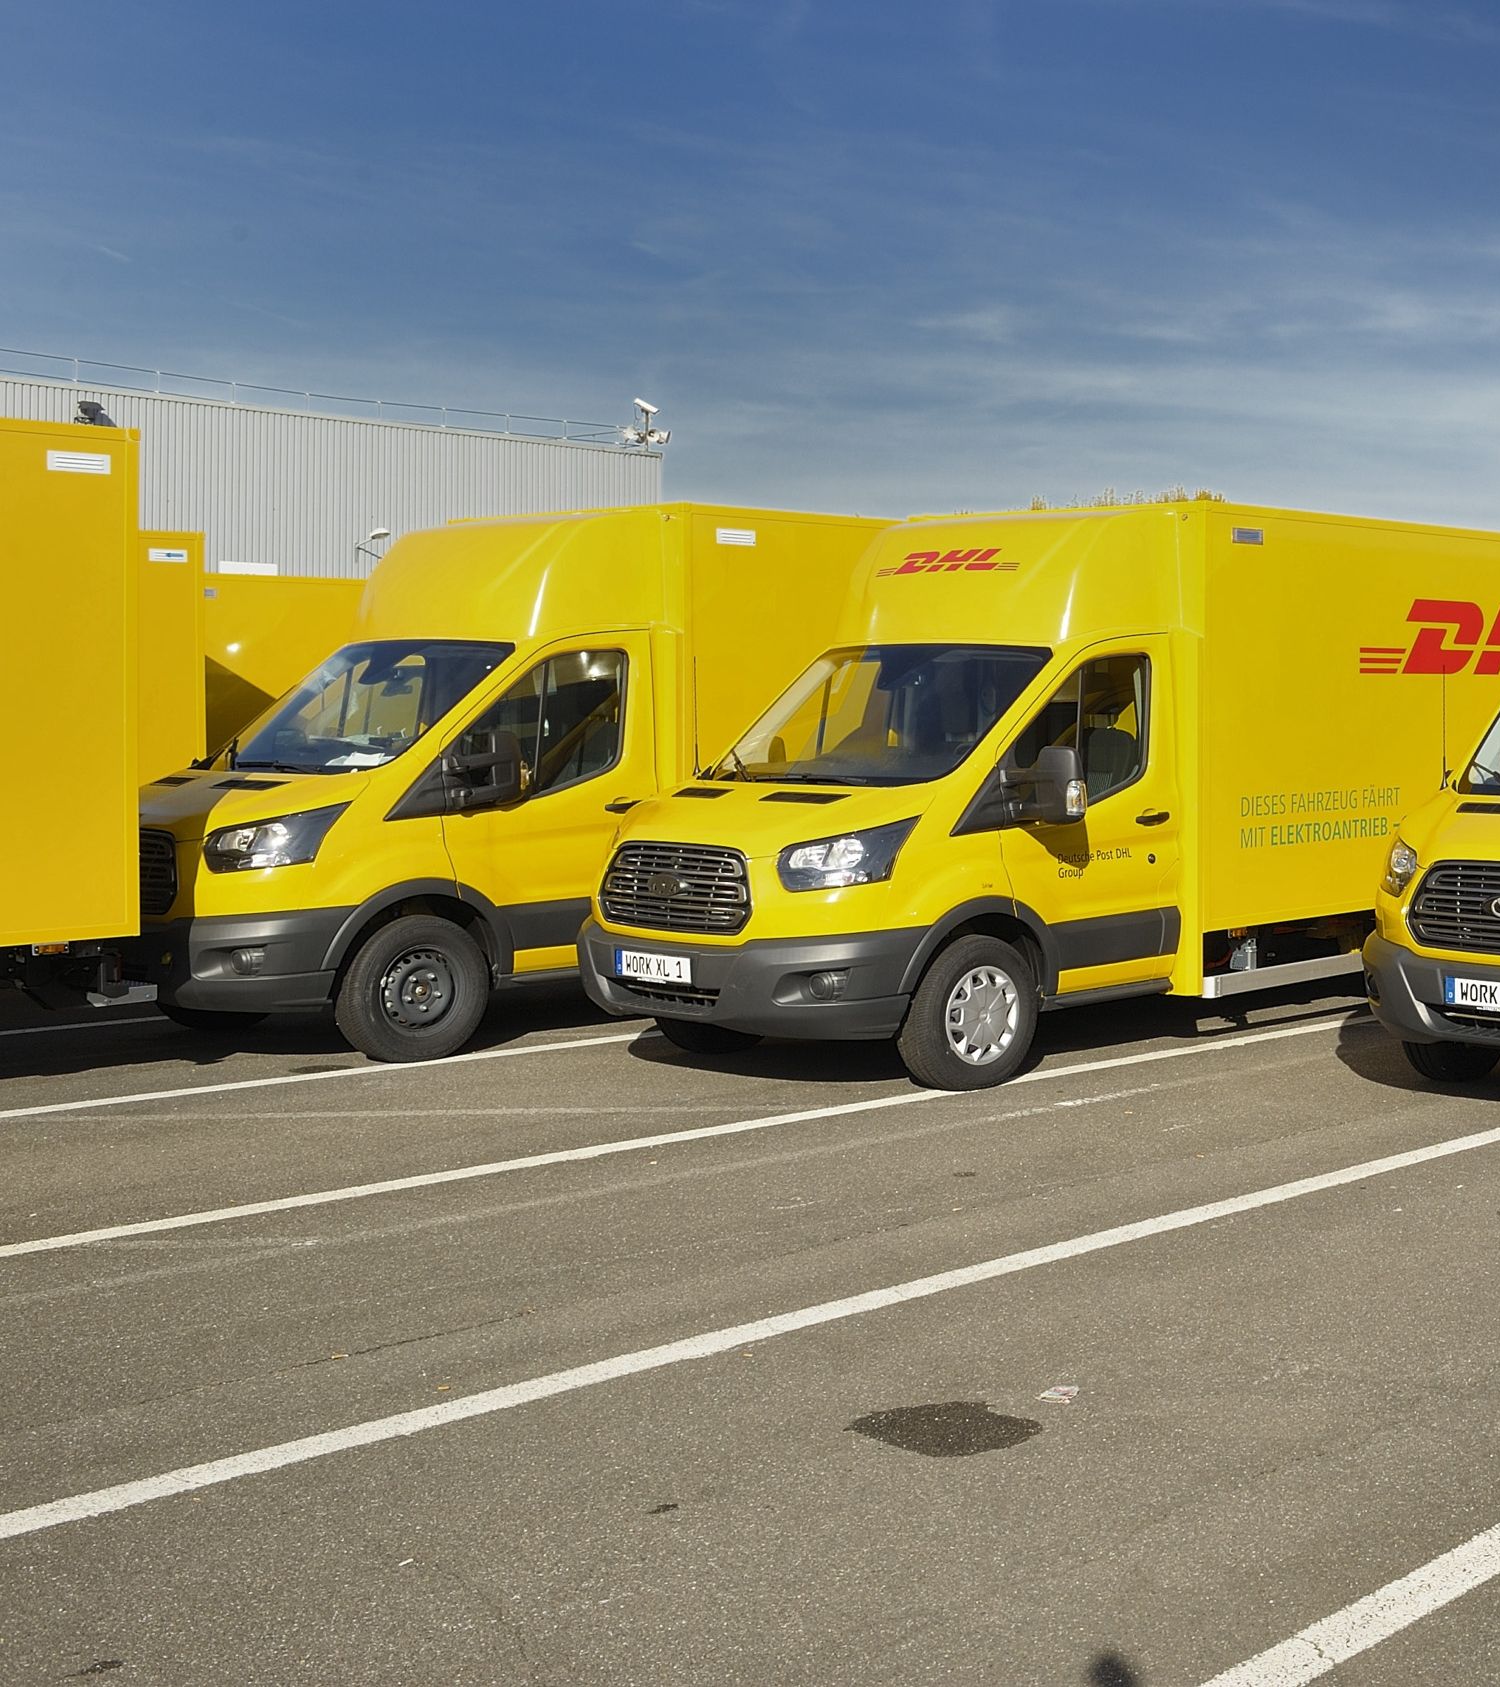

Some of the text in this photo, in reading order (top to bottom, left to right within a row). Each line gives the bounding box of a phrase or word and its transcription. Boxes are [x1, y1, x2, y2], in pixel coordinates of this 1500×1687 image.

[894, 548, 1002, 575] DHL
[1240, 785, 1400, 817] DIESES FAHRZEUG FÄHRT
[1240, 826, 1266, 849] MIT
[1057, 848, 1132, 865] Deutsche Post DHL
[1058, 867, 1084, 879] Group
[625, 954, 683, 978] WORK XL 1
[1460, 982, 1498, 1004] WORK
